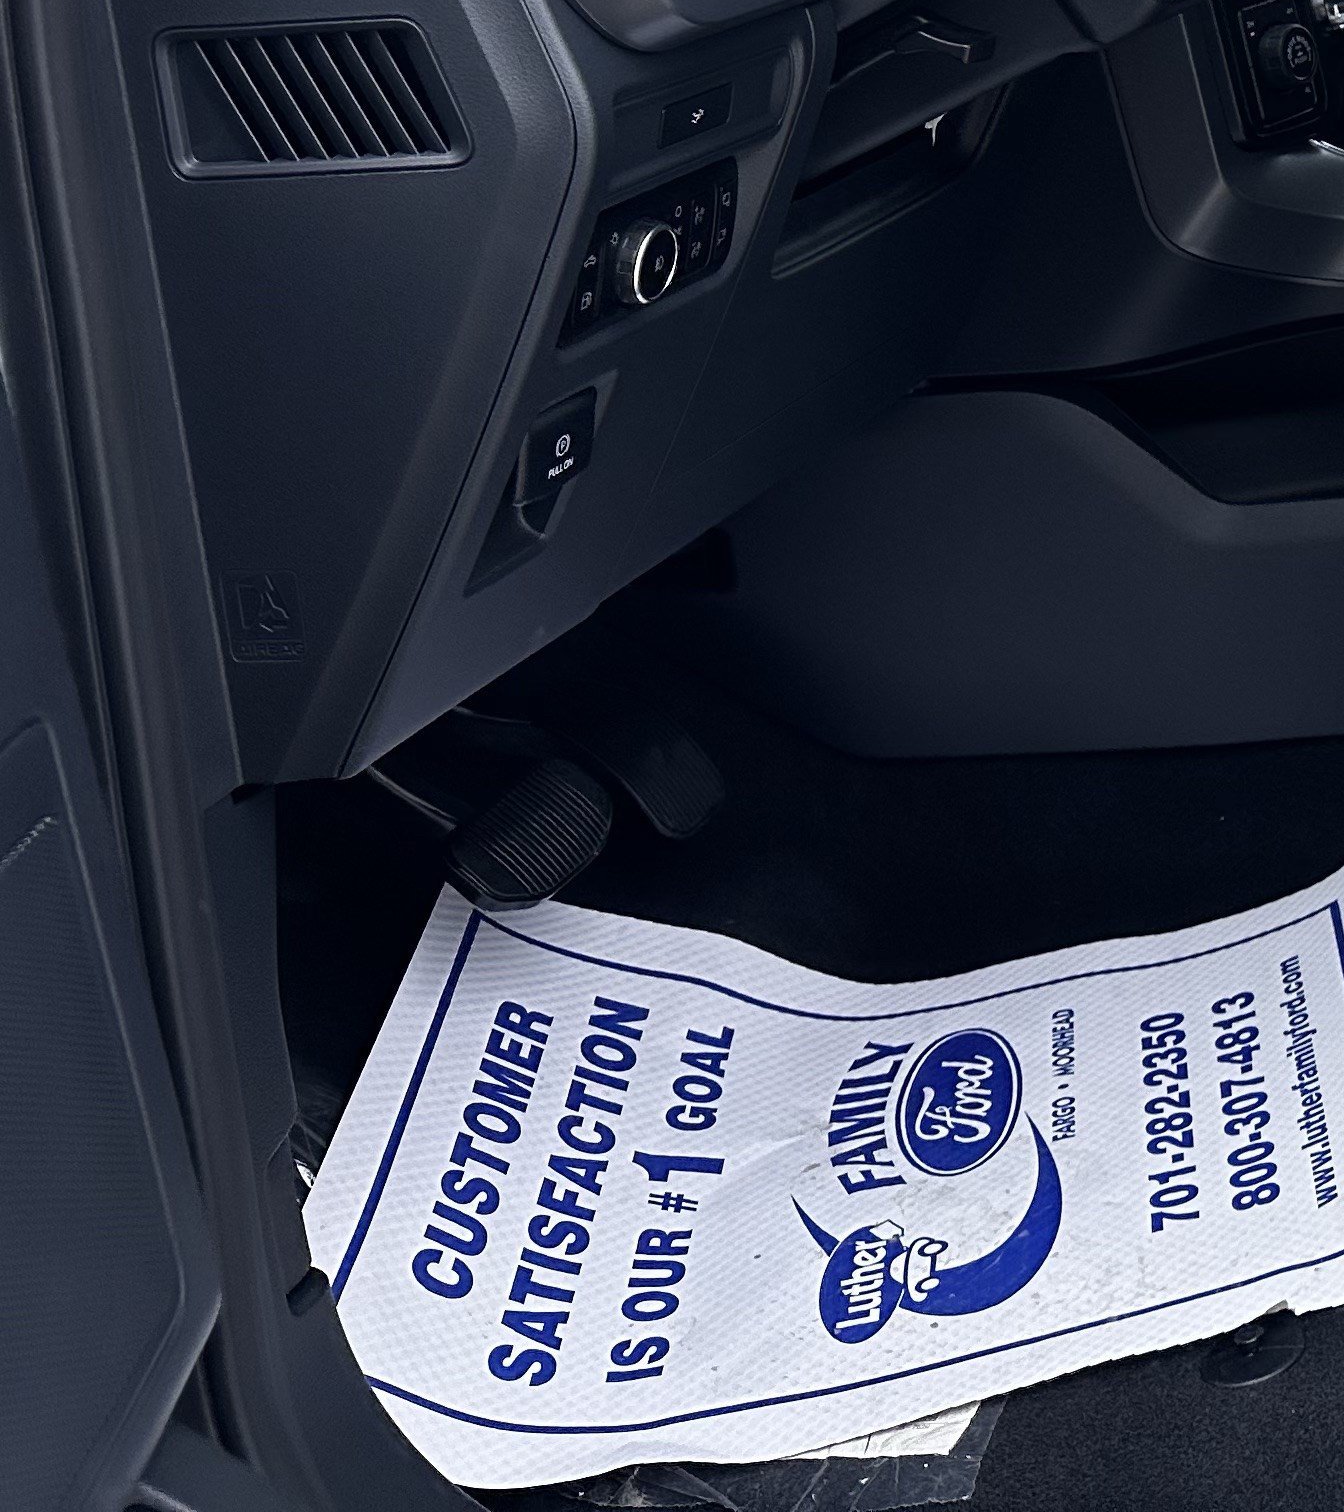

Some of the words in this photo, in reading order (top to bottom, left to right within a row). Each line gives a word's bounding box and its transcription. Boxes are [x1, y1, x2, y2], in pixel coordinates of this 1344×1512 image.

[548, 463, 563, 479] PULL
[665, 1026, 735, 1131] GOAL
[1052, 1008, 1075, 1076] MOORHEAD
[1280, 955, 1338, 1208] www.lutherfamilyford.com
[828, 1041, 915, 1195] FAMILY
[915, 1054, 994, 1144] Ford
[1052, 1096, 1076, 1143] FARGO
[1140, 1012, 1200, 1233] 701-282-2350
[1211, 991, 1281, 1210] 800-307-4813
[412, 1000, 554, 1299] CUSTOMER
[488, 996, 650, 1386] SATISFACTION
[621, 1228, 693, 1322] OUR
[836, 1239, 888, 1330] Luther
[605, 1336, 670, 1383] IS
